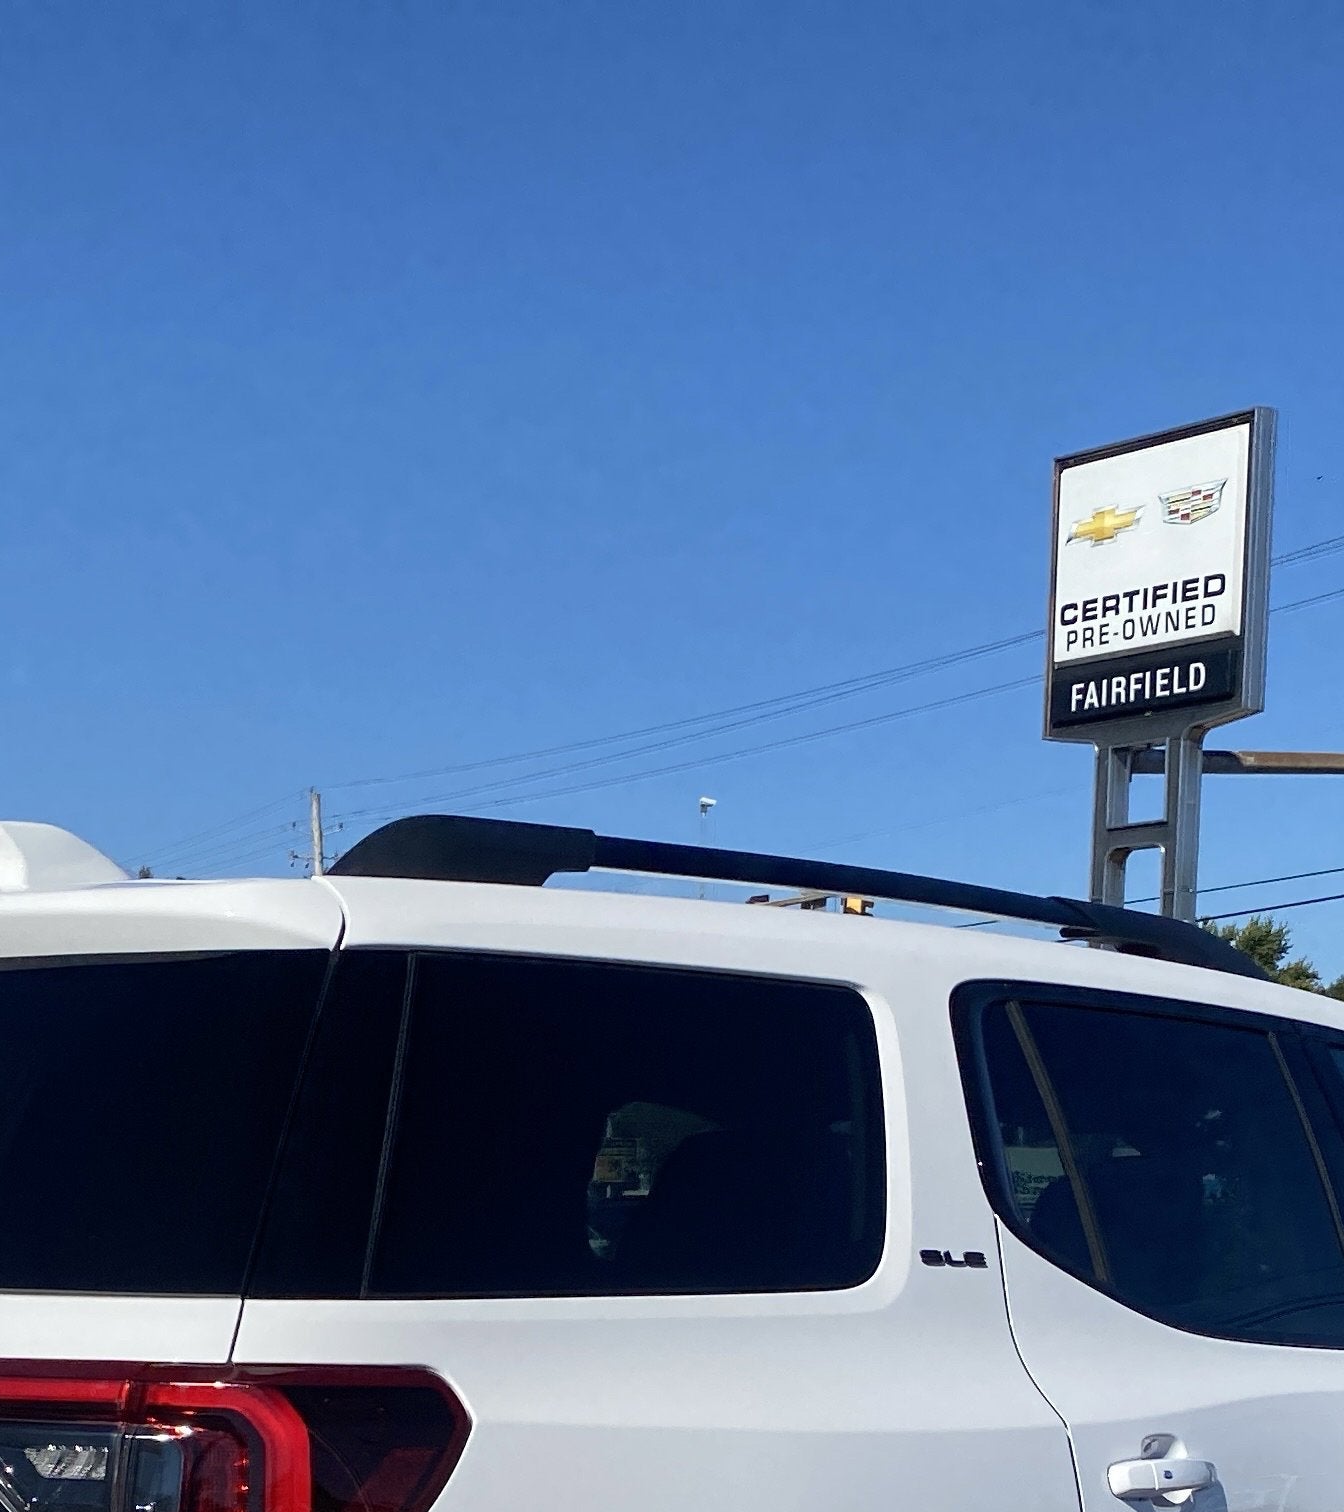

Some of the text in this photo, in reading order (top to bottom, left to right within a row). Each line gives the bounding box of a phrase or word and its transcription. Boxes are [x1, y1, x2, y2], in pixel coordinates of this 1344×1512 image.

[1060, 573, 1226, 626] CERTIFIED
[1066, 603, 1216, 652] PRE-OWNED
[1070, 662, 1207, 713] FAIRFIELD
[919, 1249, 989, 1269] SLE
